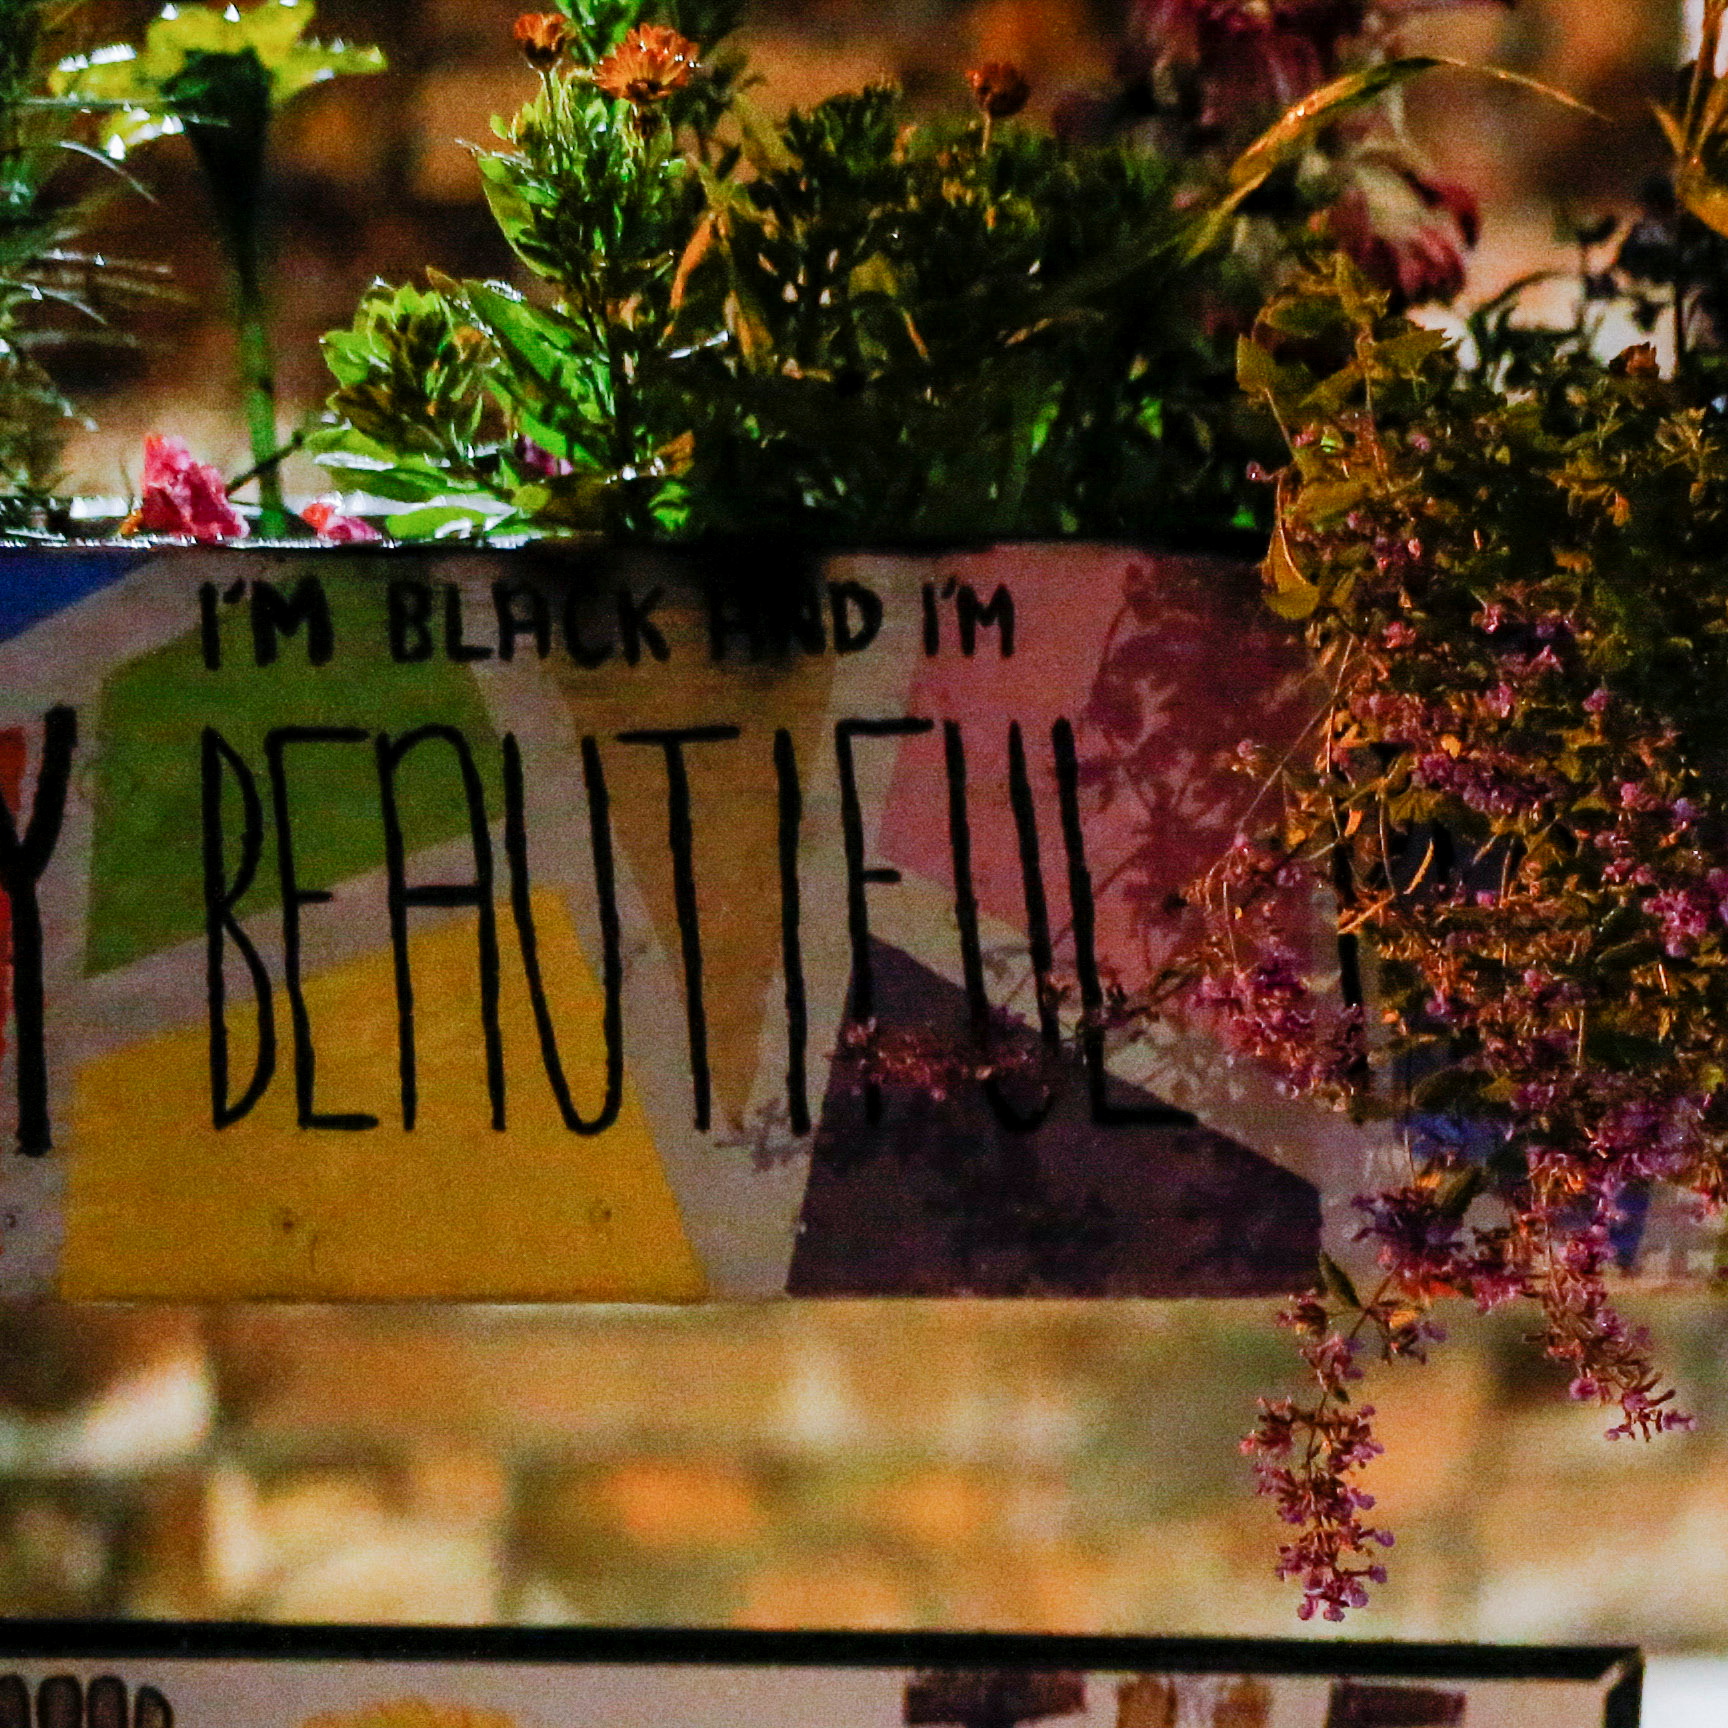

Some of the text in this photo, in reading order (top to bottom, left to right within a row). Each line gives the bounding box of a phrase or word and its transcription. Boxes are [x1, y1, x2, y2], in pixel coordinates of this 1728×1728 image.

[200, 576, 334, 668] I'M
[389, 582, 669, 666] BLACK
[922, 578, 1015, 657] I'M
[200, 716, 1198, 1137] BEAUTIFUL
